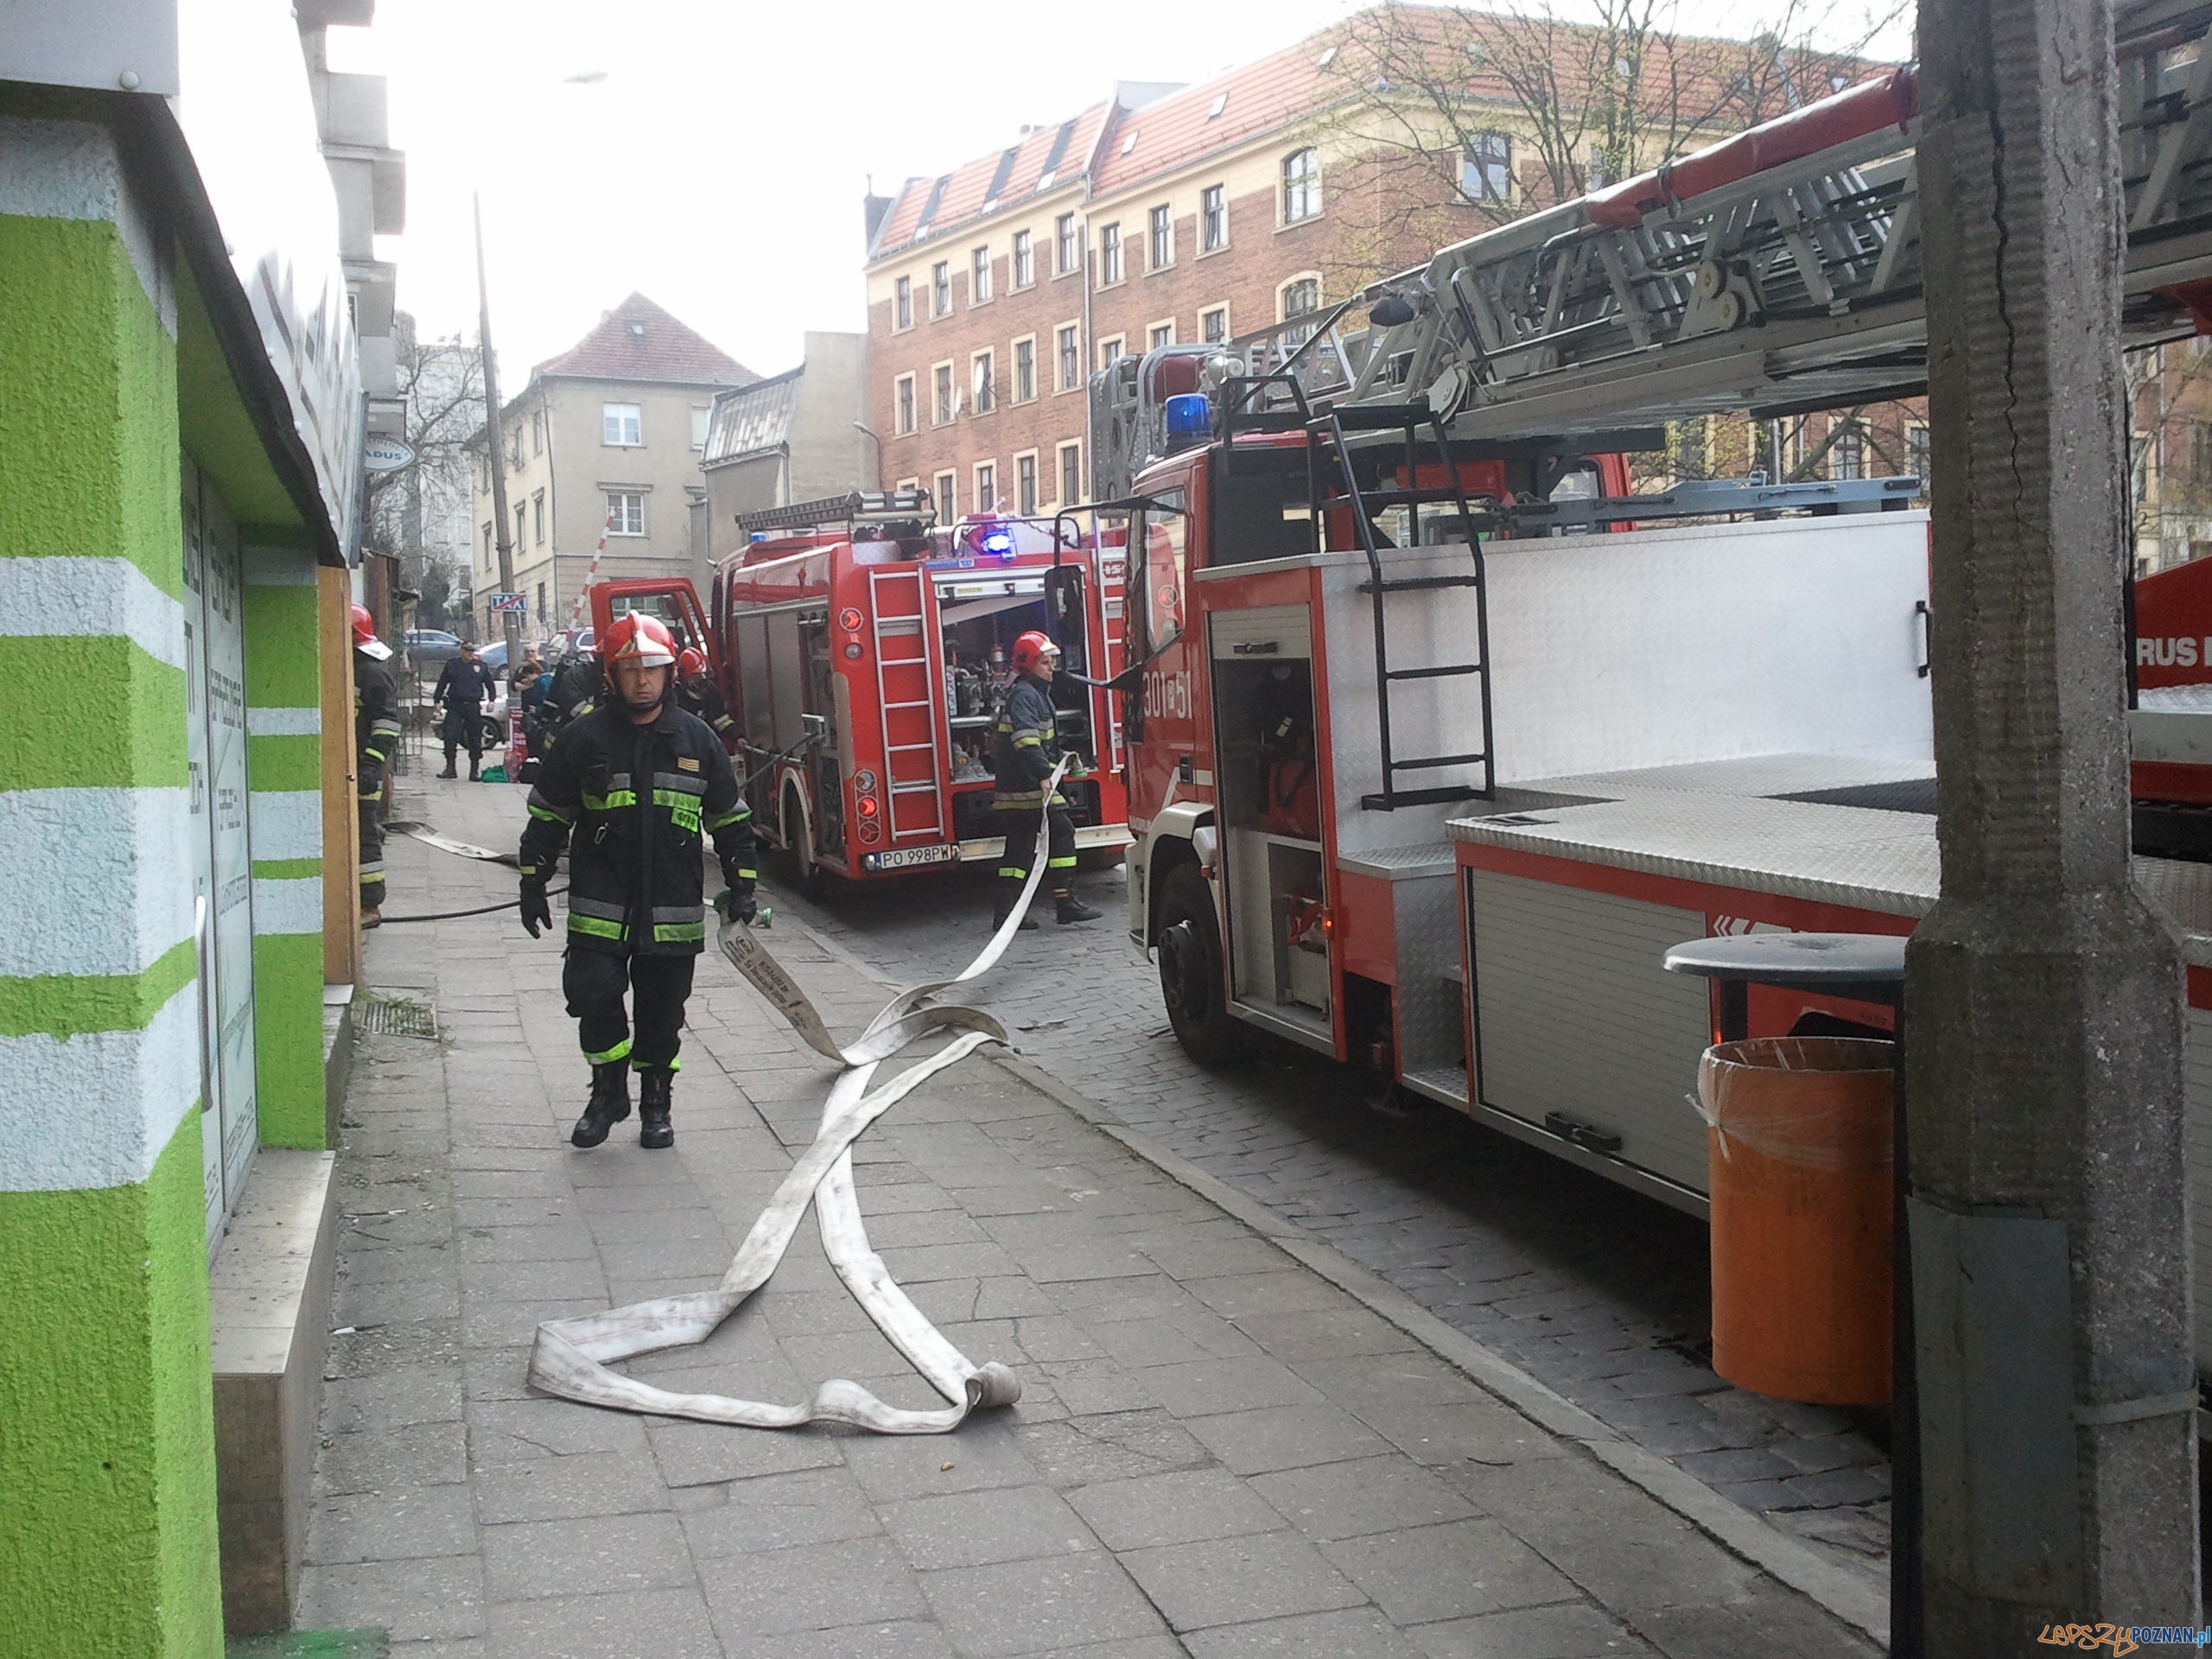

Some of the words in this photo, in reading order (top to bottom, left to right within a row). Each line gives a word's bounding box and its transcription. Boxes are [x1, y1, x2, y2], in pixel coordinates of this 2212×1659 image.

[493, 595, 526, 609] TAXI
[882, 852, 903, 867] PO
[907, 846, 949, 863] 998PW
